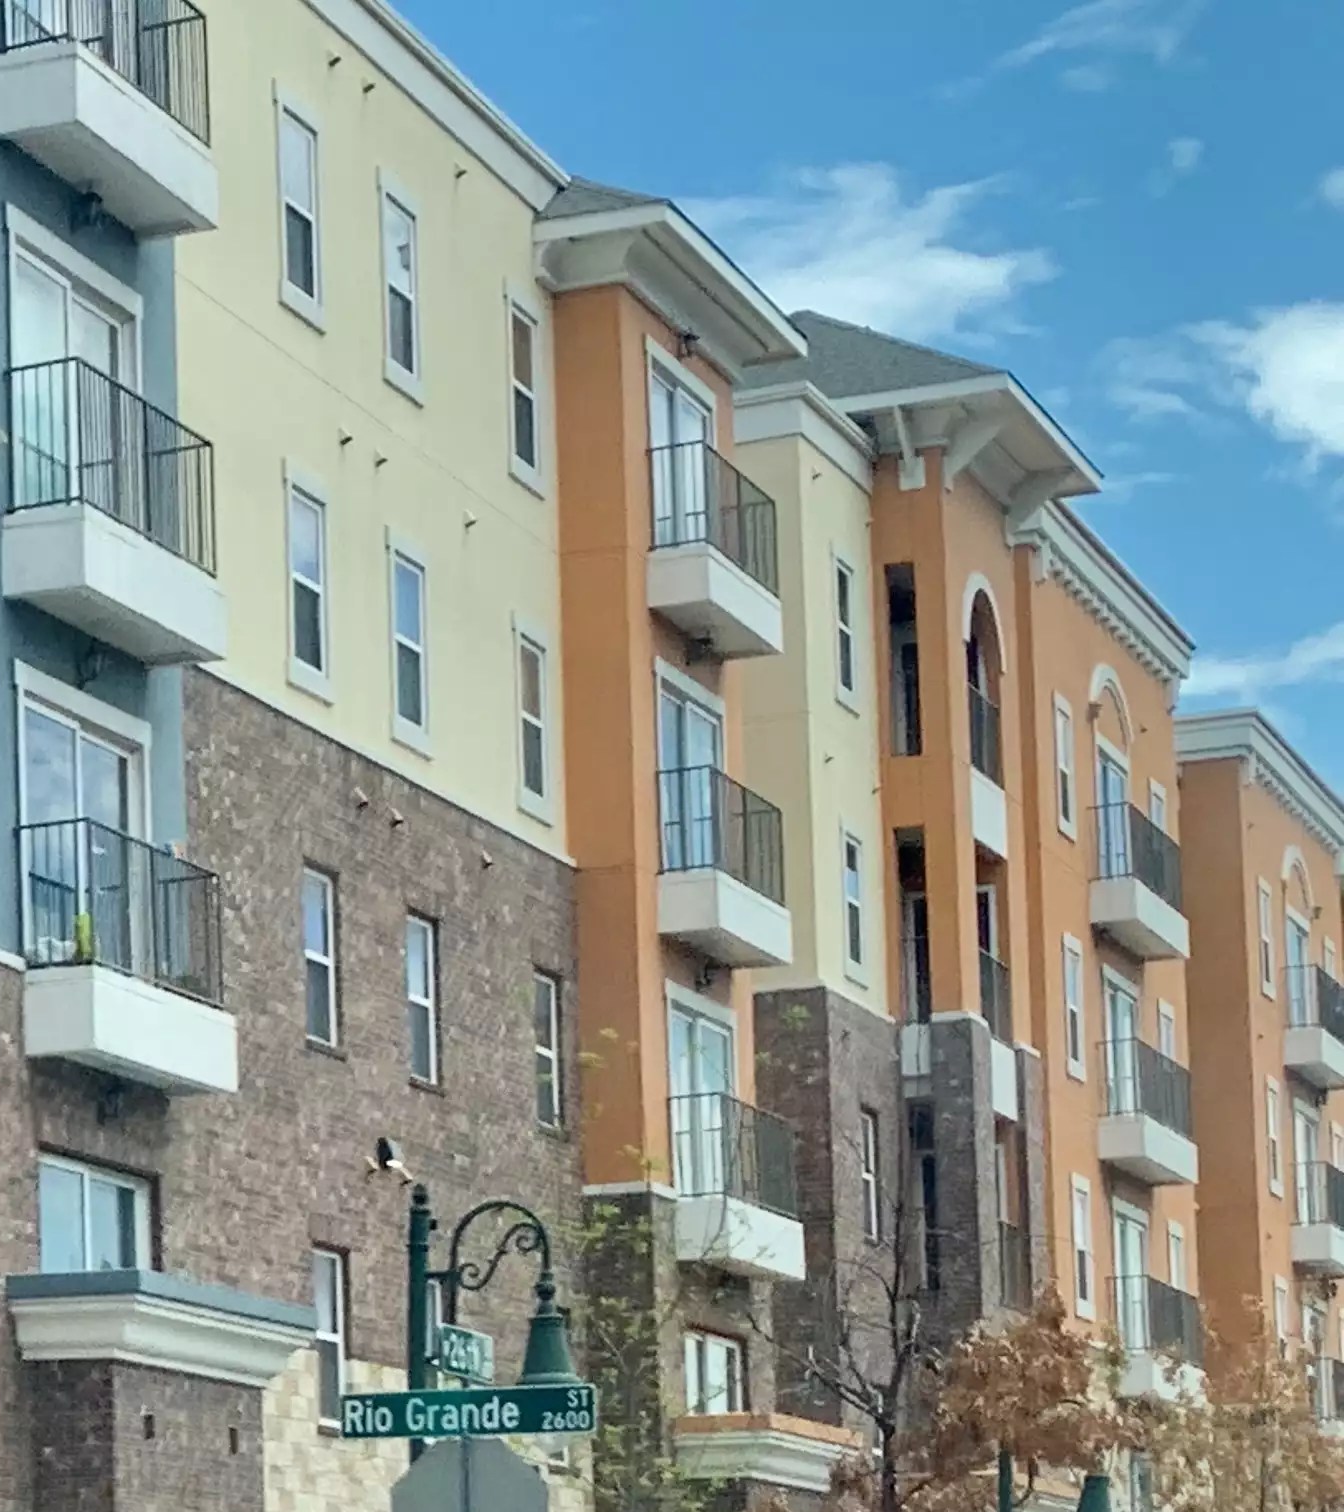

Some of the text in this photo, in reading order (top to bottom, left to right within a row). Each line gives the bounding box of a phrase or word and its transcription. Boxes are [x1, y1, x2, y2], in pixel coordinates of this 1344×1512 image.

[567, 1386, 590, 1408] ST
[344, 1396, 520, 1433] Rio Grande
[542, 1410, 591, 1431] 2600
